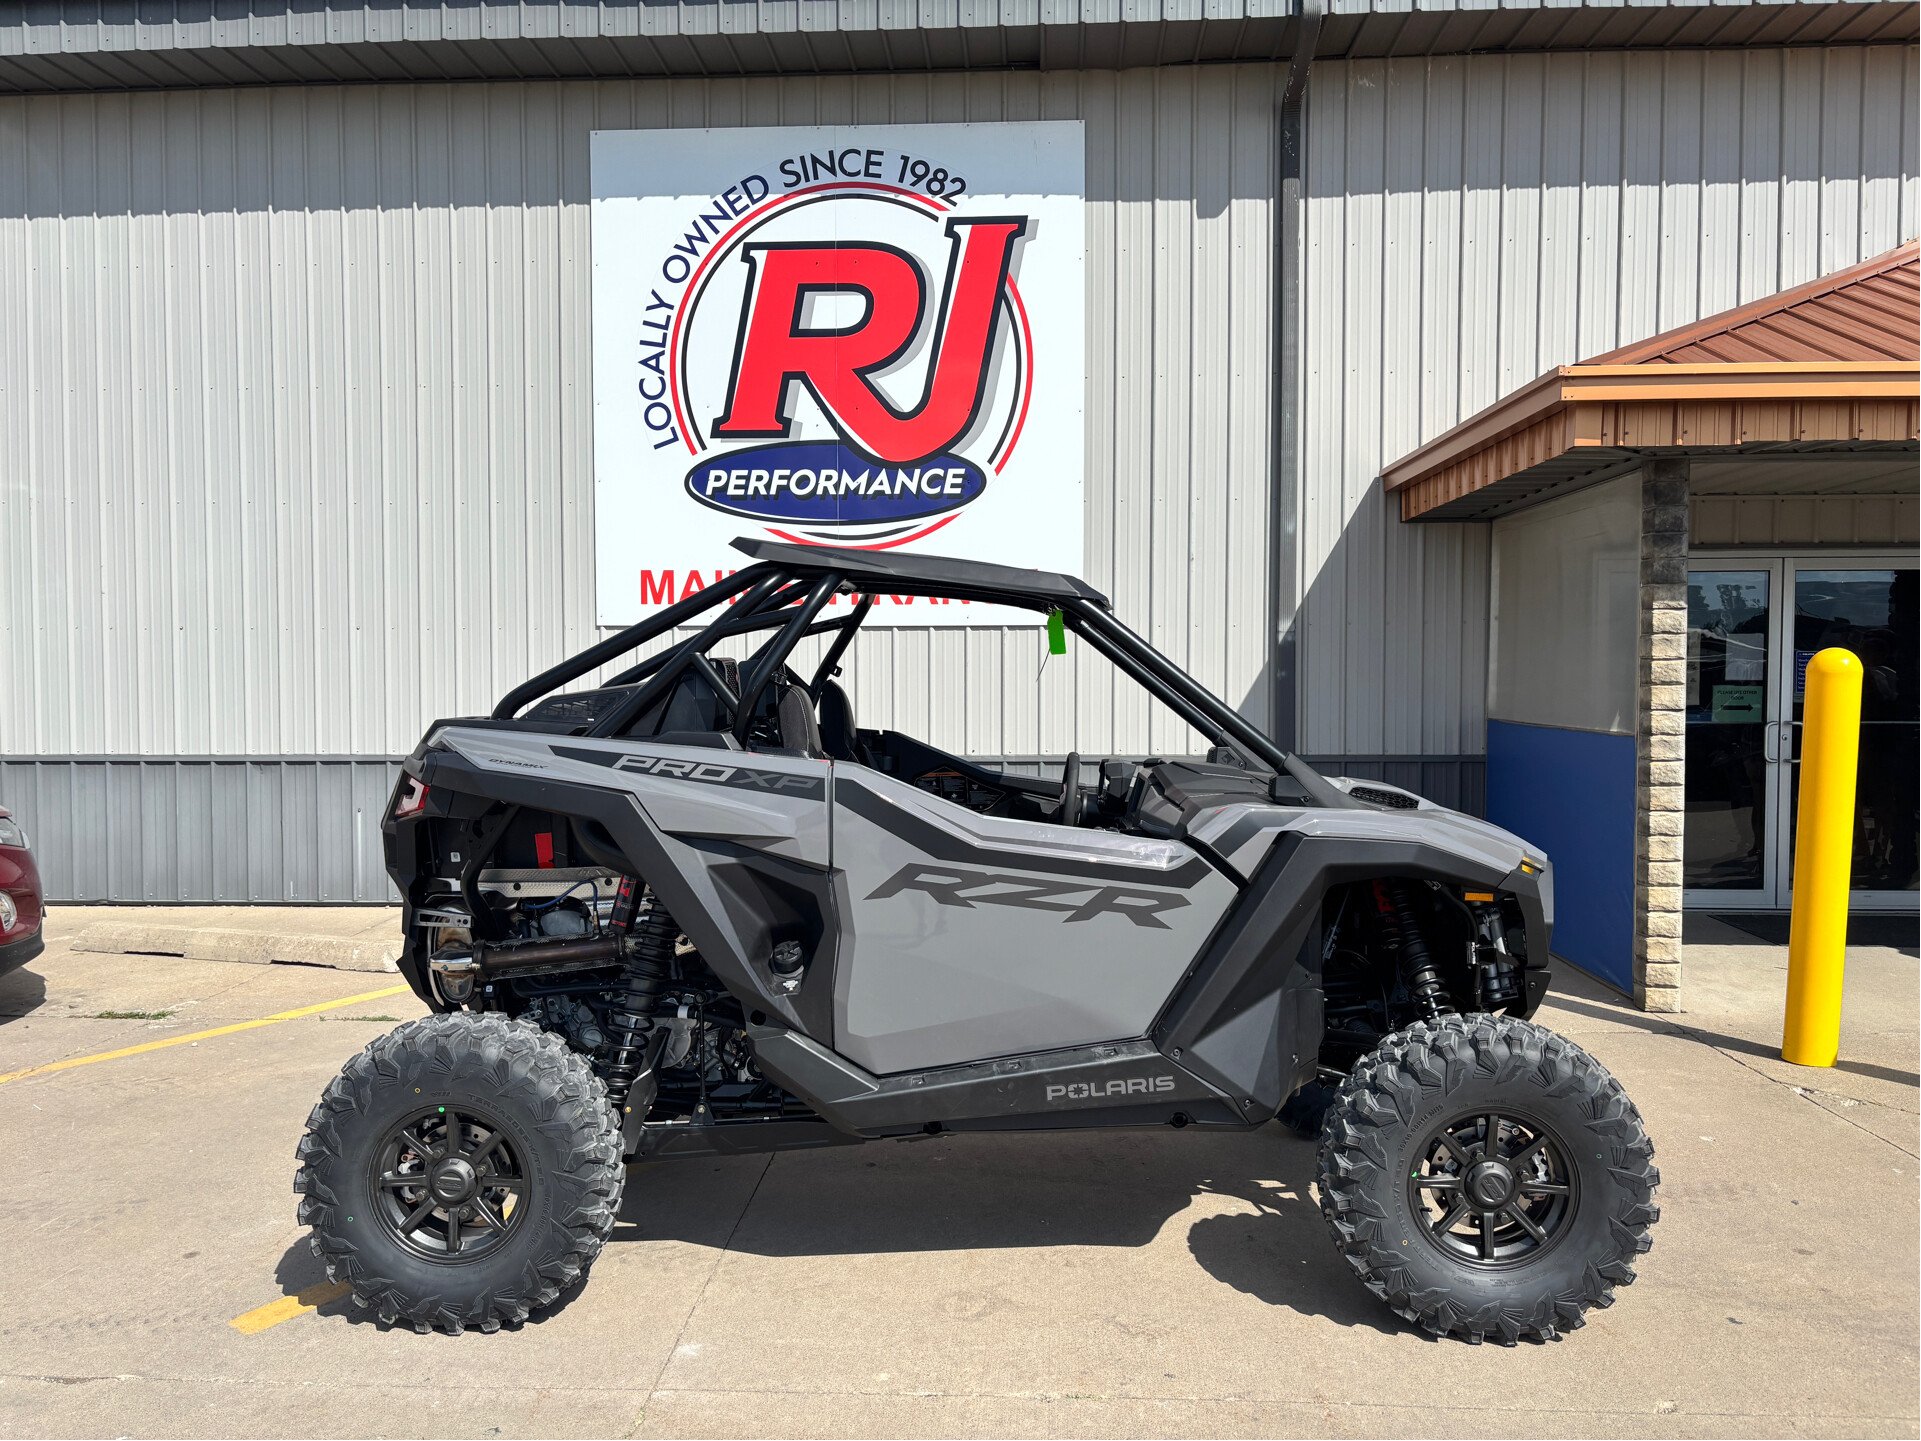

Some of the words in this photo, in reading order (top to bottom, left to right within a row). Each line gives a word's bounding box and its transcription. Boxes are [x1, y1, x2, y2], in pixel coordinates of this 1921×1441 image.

[638, 288, 680, 450] LOCALLY
[662, 174, 770, 283] OWNED
[779, 148, 885, 188] SINCE
[897, 154, 967, 207] 1982
[710, 215, 1029, 469] RJ
[705, 467, 966, 497] PERFORMANCE
[612, 754, 738, 783] PRO
[733, 770, 822, 790] XP
[862, 862, 1193, 930] RZR
[1046, 1075, 1176, 1101] POLARIS
